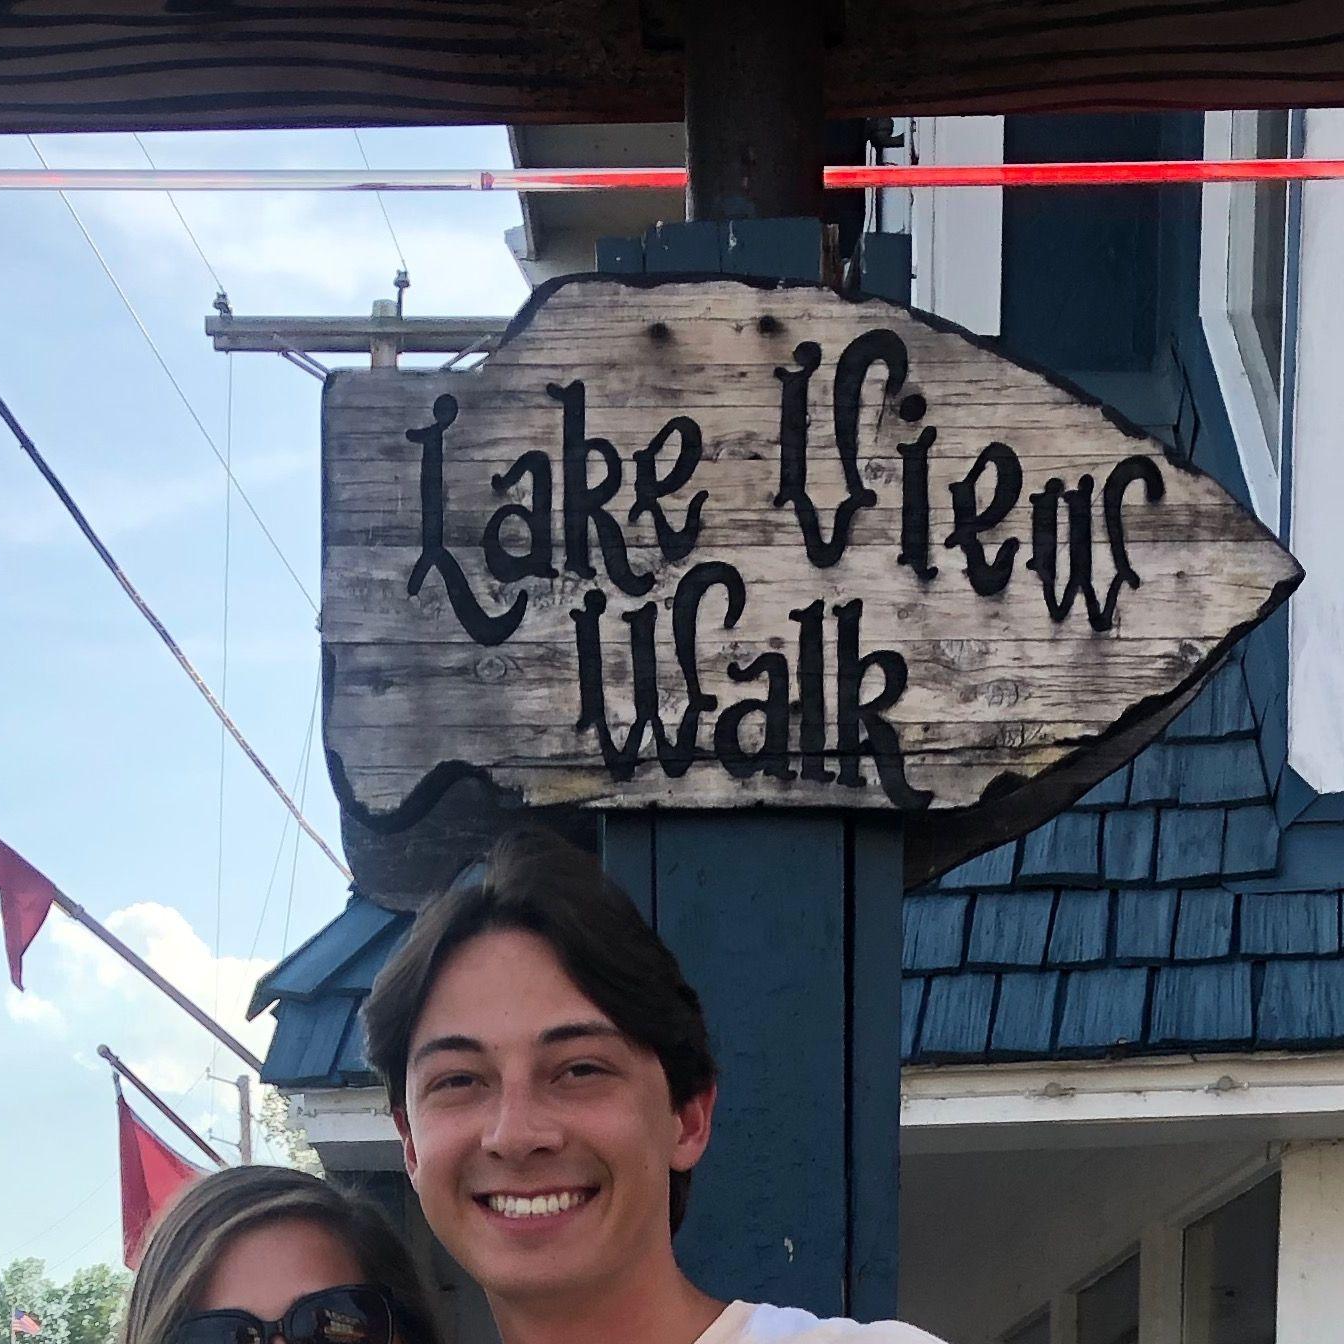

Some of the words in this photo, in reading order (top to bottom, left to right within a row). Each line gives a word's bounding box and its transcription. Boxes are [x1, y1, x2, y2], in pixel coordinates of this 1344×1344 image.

[406, 380, 709, 647] Lake
[771, 328, 1166, 632] View
[567, 560, 936, 811] Walk
